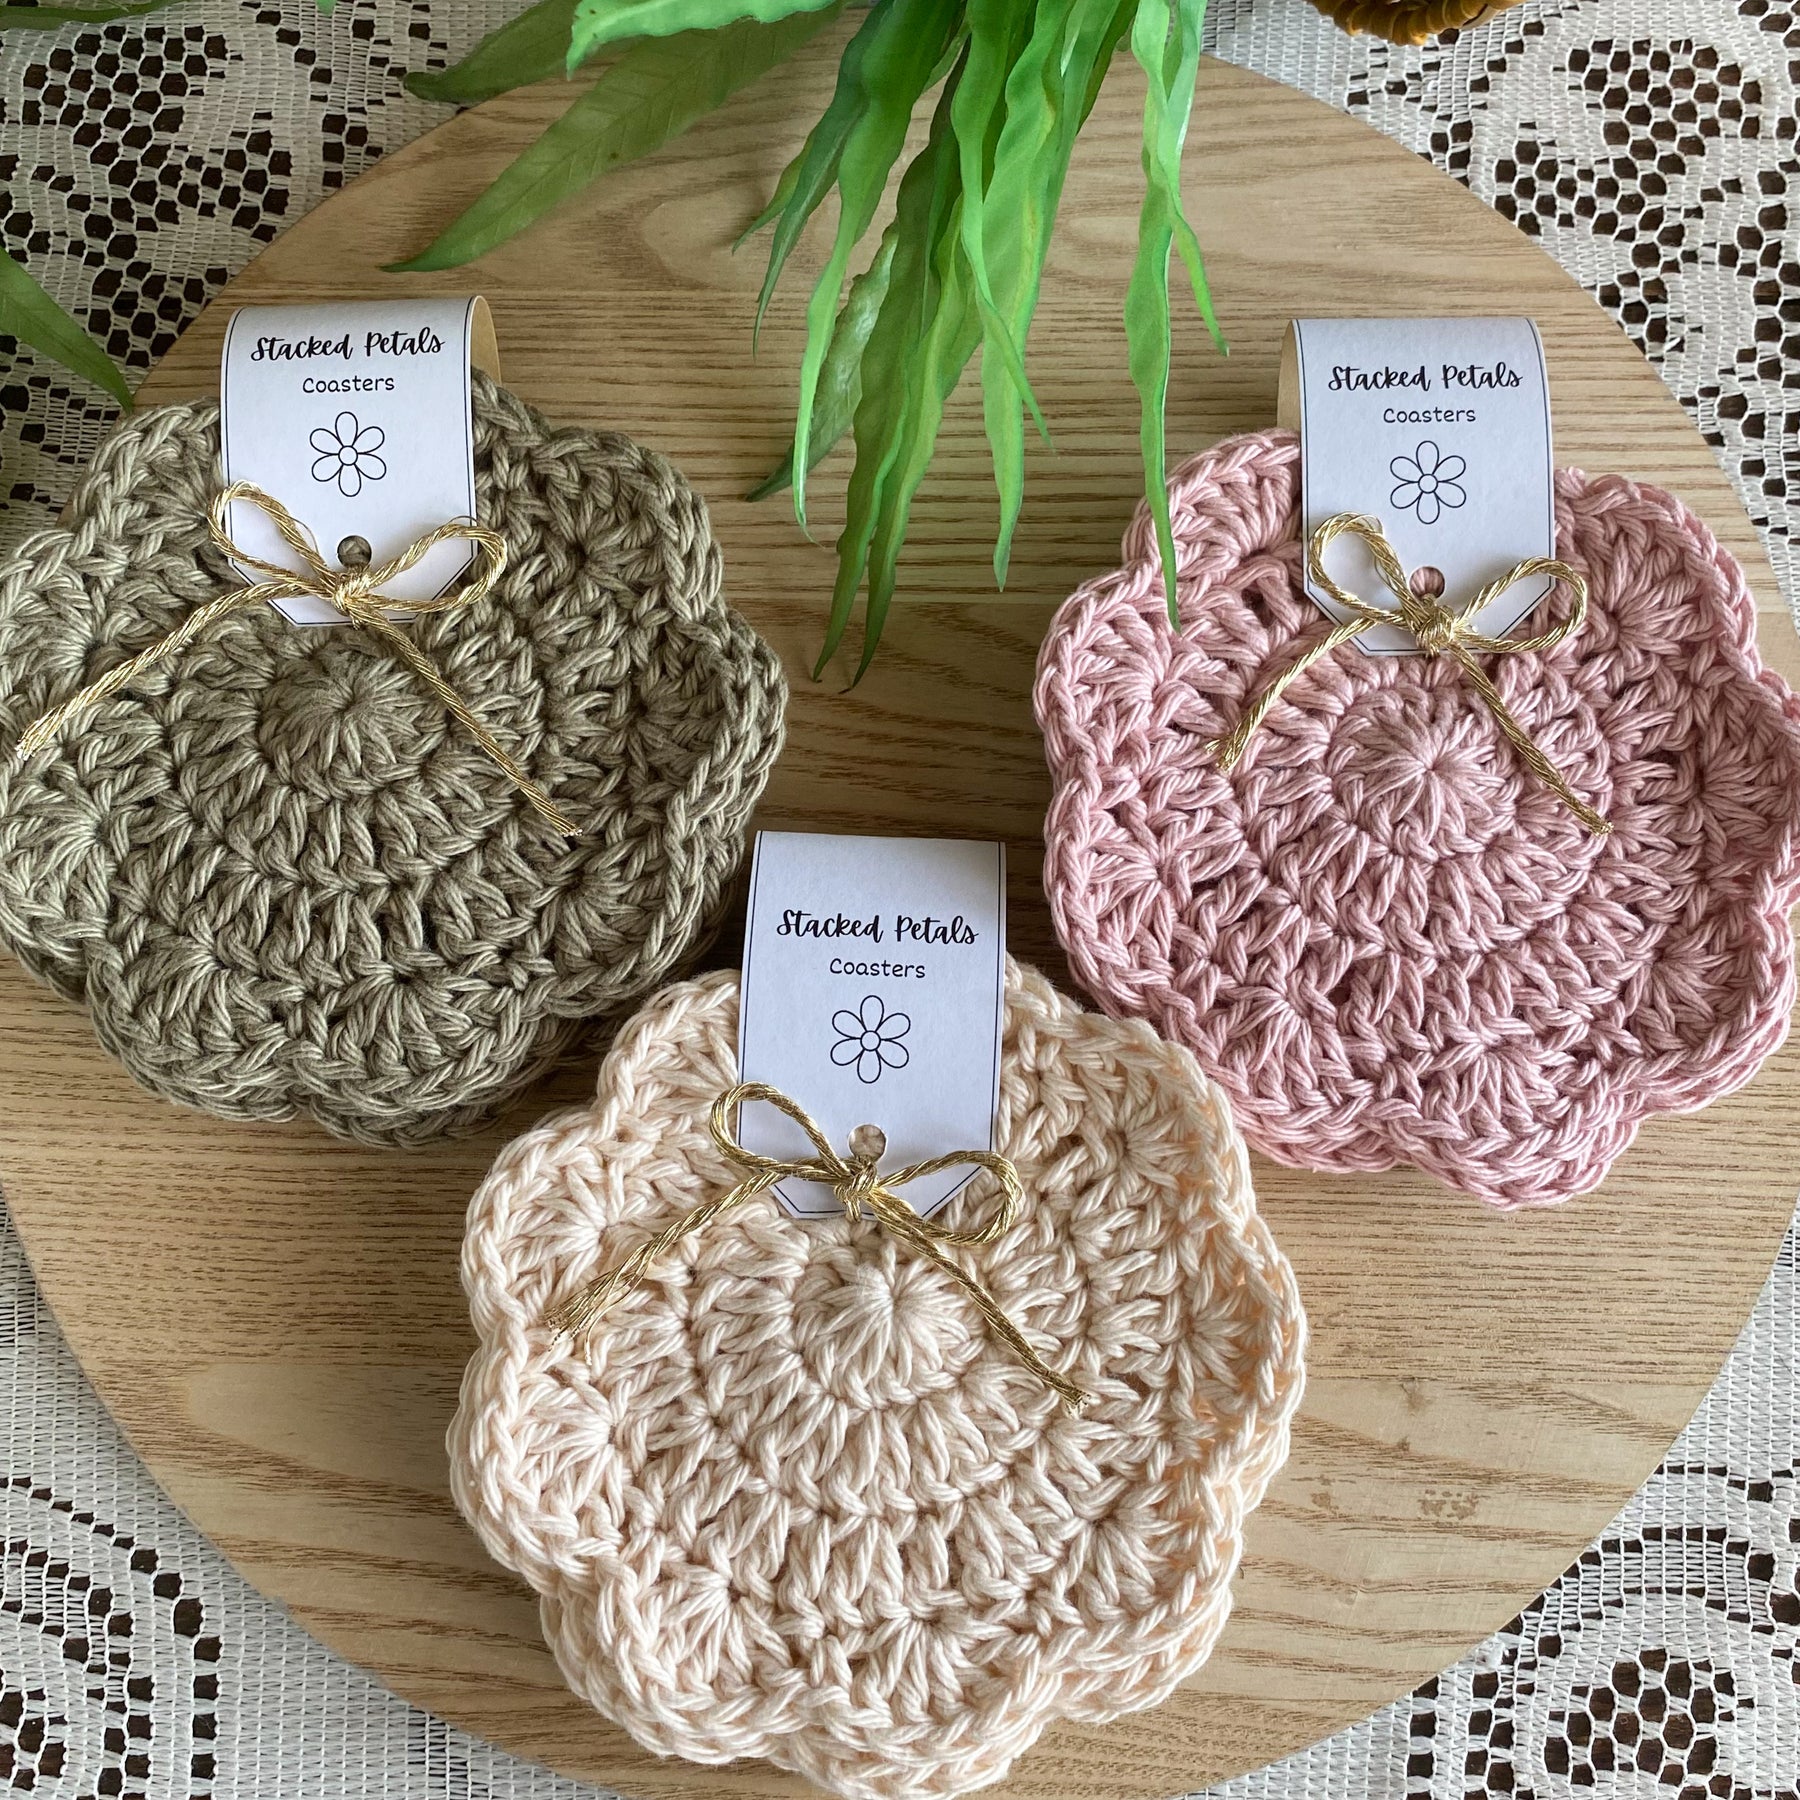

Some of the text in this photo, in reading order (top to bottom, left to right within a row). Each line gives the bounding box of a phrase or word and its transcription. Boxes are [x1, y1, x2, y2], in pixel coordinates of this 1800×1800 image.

[251, 326, 446, 362] Stacked Petals
[302, 375, 395, 394] Coasters
[1328, 361, 1524, 392] Stacked Petals
[1383, 406, 1476, 424] Coasters
[776, 909, 979, 945] Stacked Petals
[829, 957, 926, 979] Coasters
